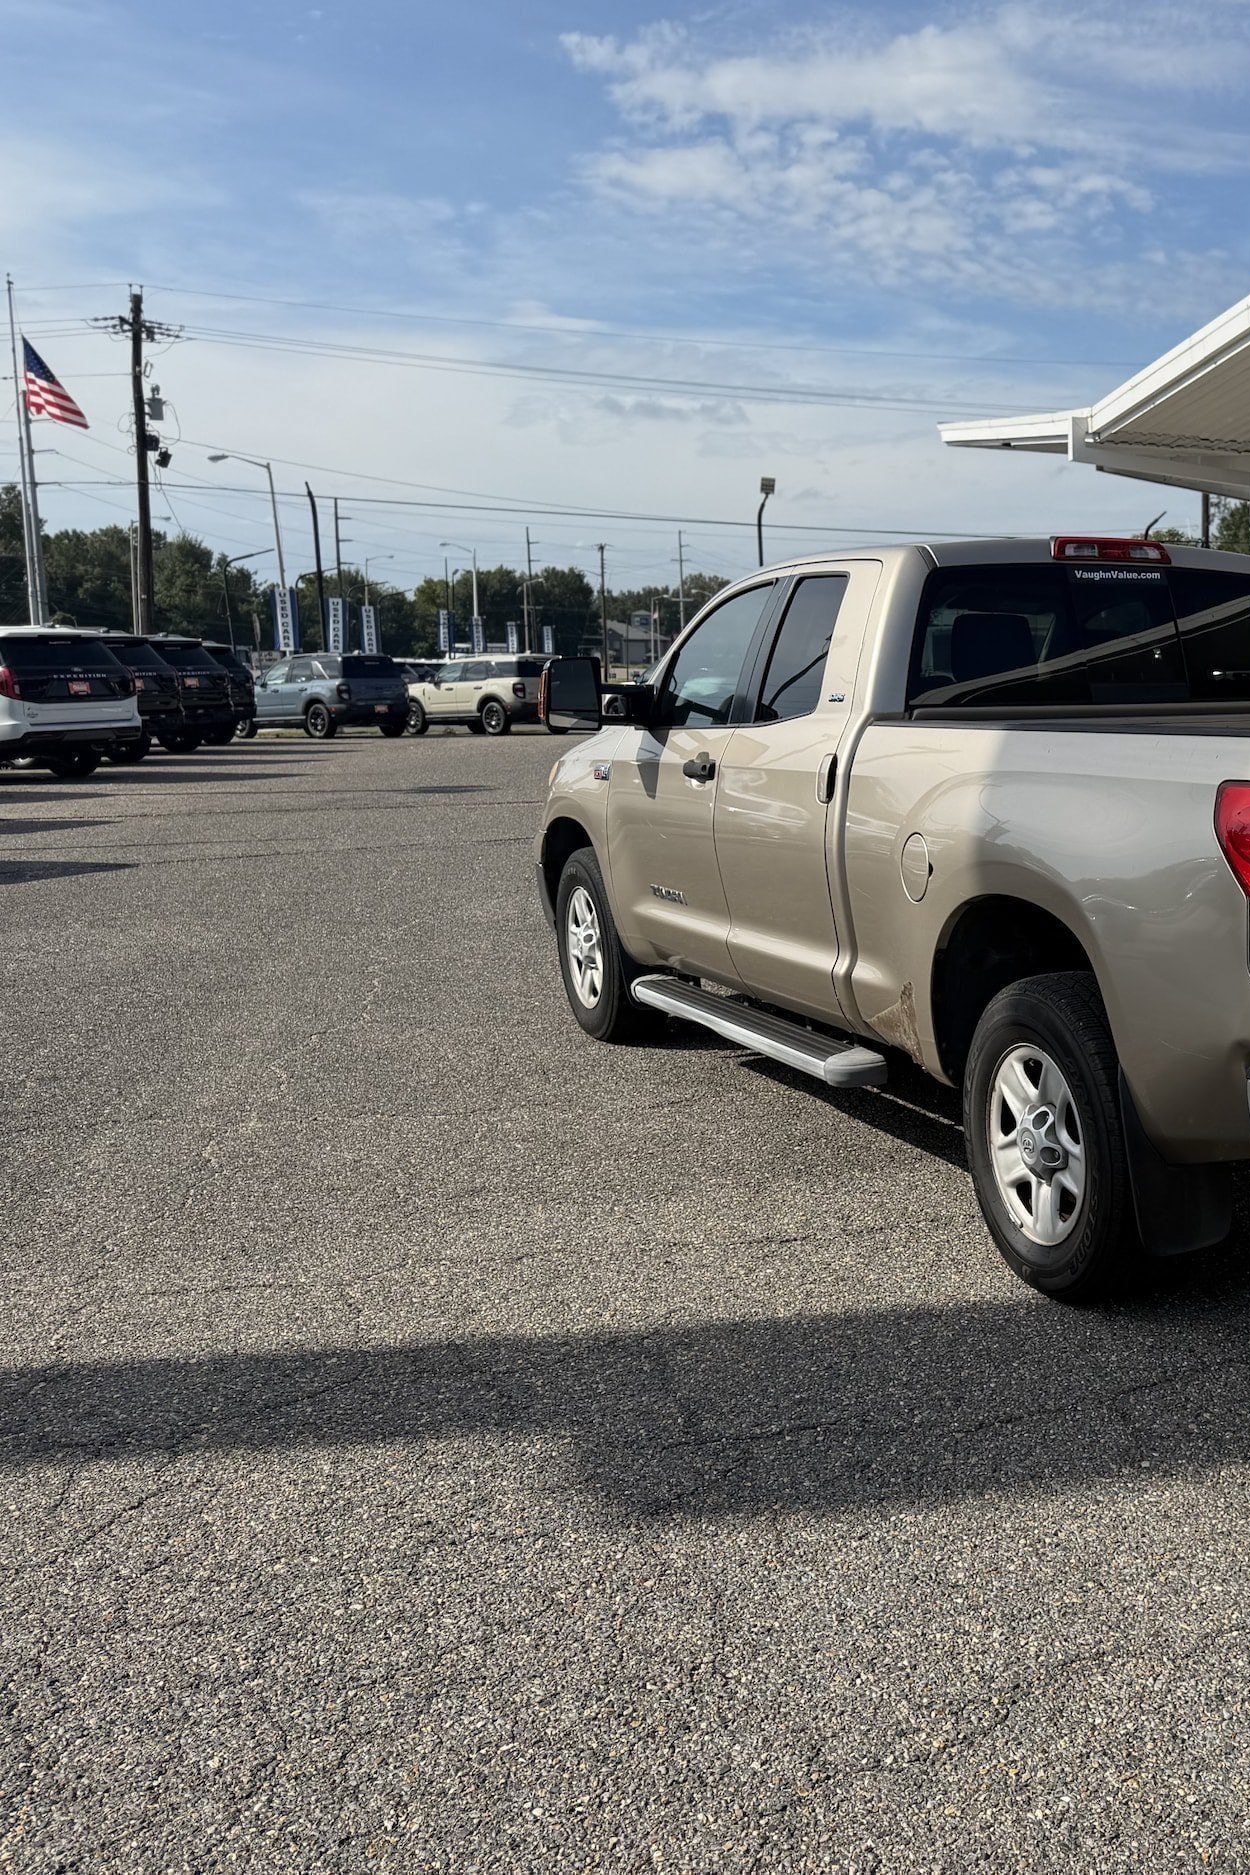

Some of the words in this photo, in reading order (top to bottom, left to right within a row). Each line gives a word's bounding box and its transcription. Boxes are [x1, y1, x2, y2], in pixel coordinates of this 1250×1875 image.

[1075, 570, 1161, 580] VaughnValue.com
[279, 592, 289, 618] USED
[332, 601, 340, 625] USED
[364, 608, 373, 630] USED
[282, 622, 290, 648] CARS
[366, 632, 375, 653] CARS
